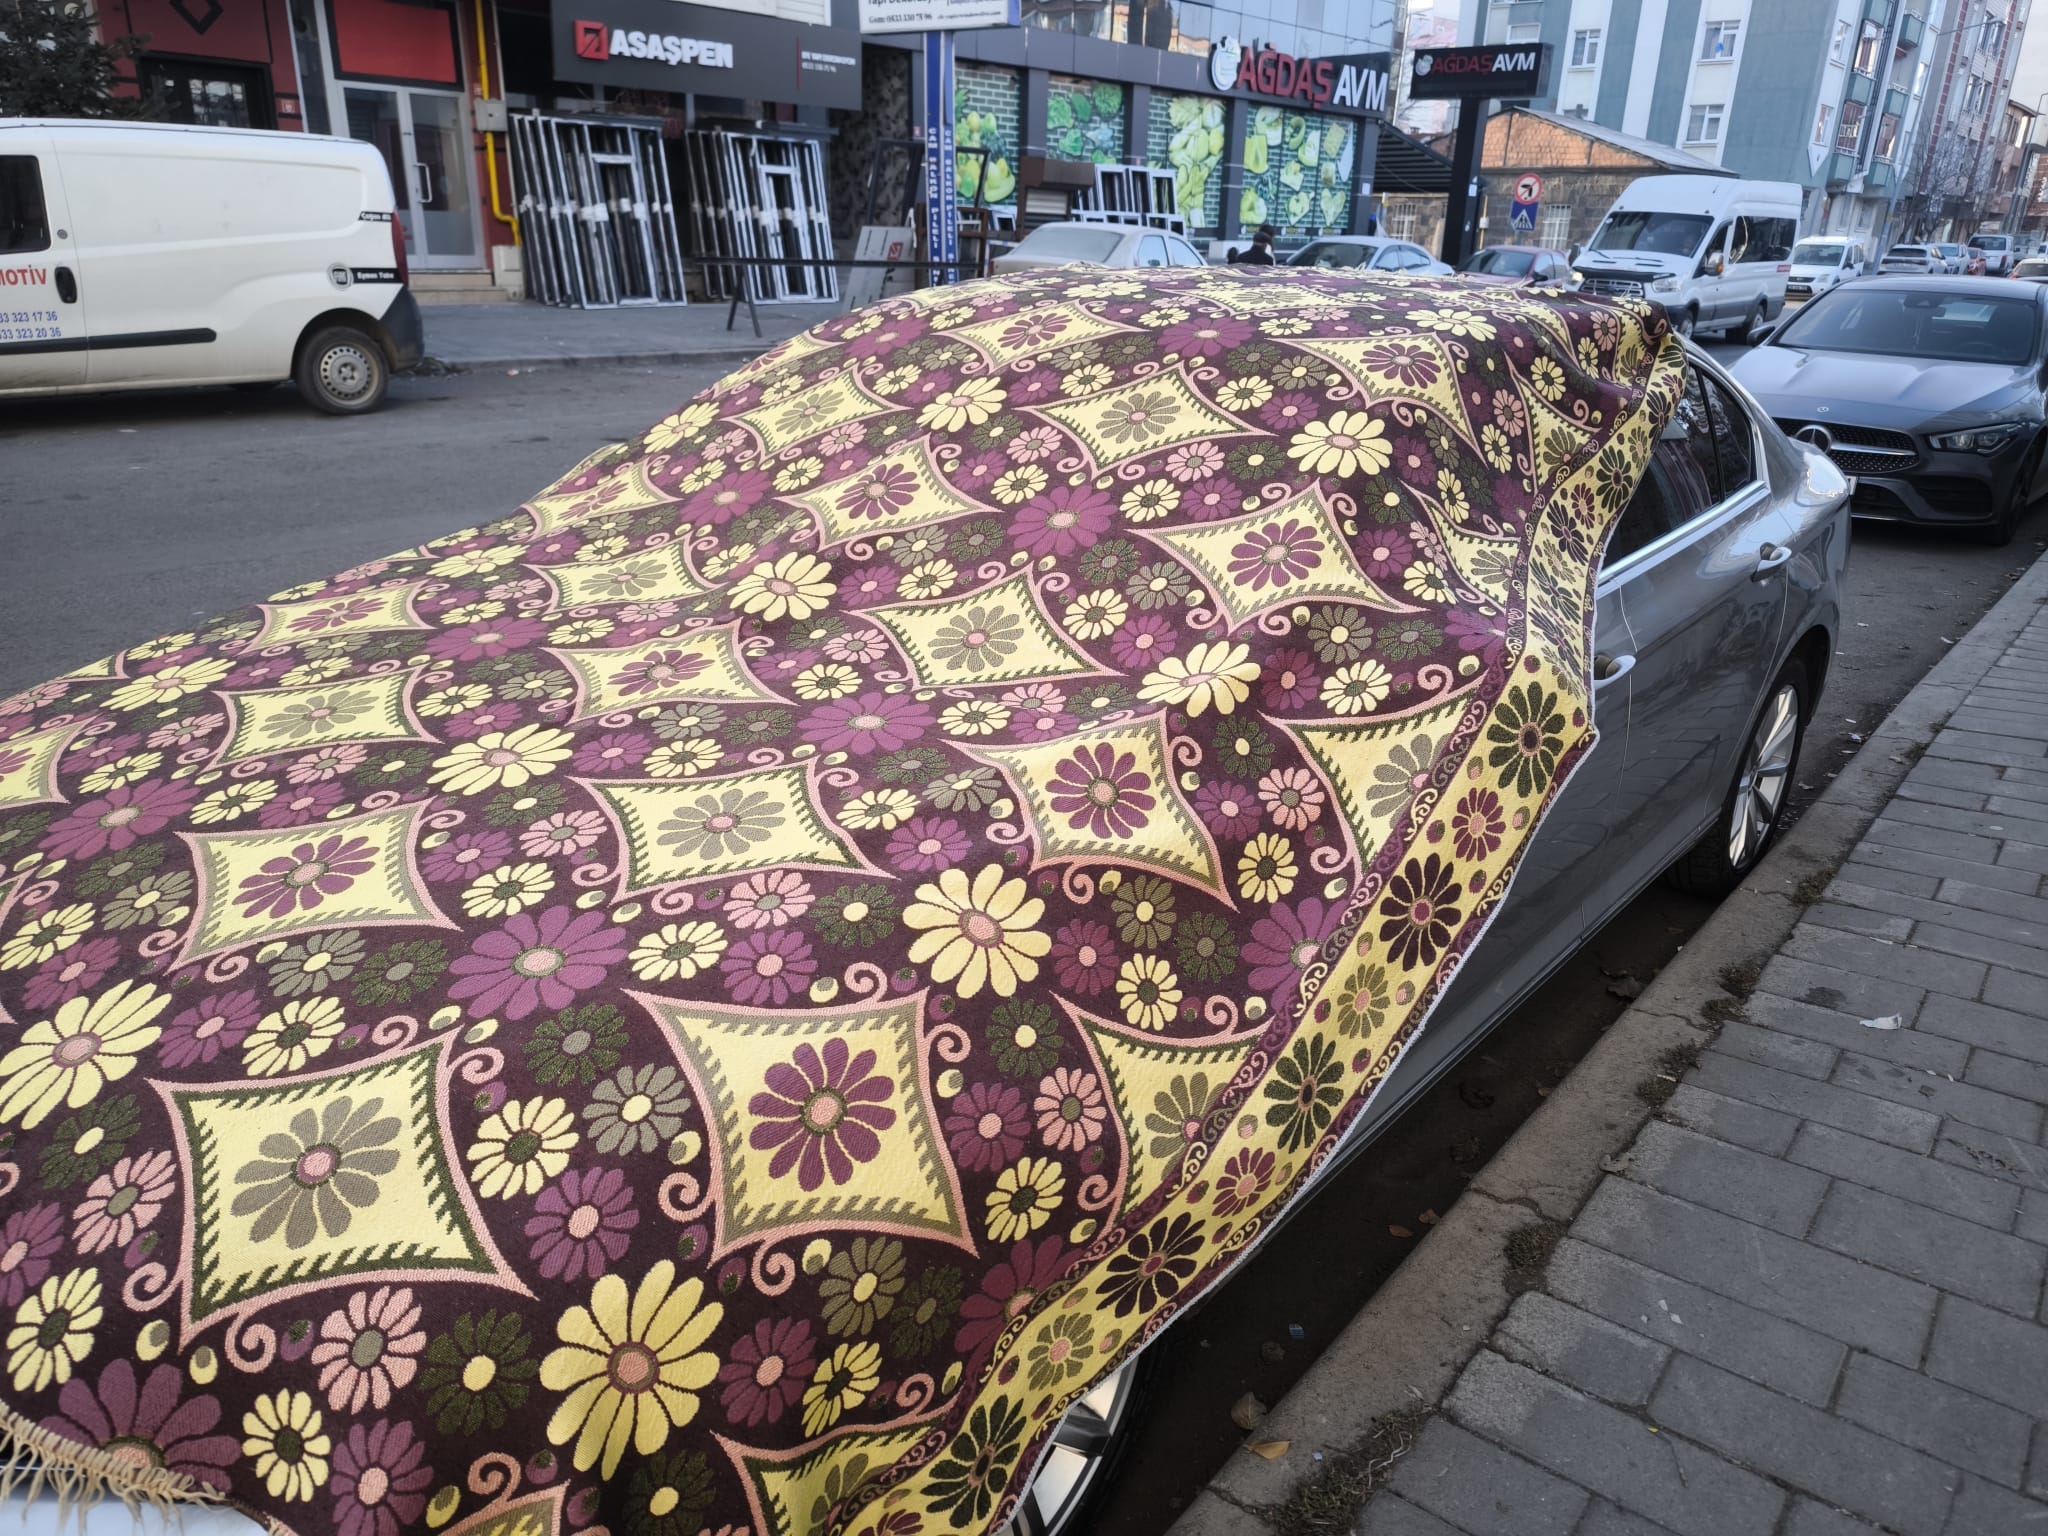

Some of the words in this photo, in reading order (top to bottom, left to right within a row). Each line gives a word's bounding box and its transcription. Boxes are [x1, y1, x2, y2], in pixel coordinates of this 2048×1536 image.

[610, 29, 733, 68] ASAŞPEN
[1491, 52, 1536, 72] AVM
[1332, 64, 1389, 112] AVM
[928, 127, 938, 149] CAM
[944, 129, 953, 151] CAM
[929, 157, 938, 200] BALKON
[945, 158, 953, 201] BALKON
[12, 312, 30, 322] 323
[32, 312, 42, 321] 17
[46, 311, 57, 321] 36
[16, 328, 33, 339] 323
[36, 327, 48, 338] 20
[50, 328, 61, 337] 36
